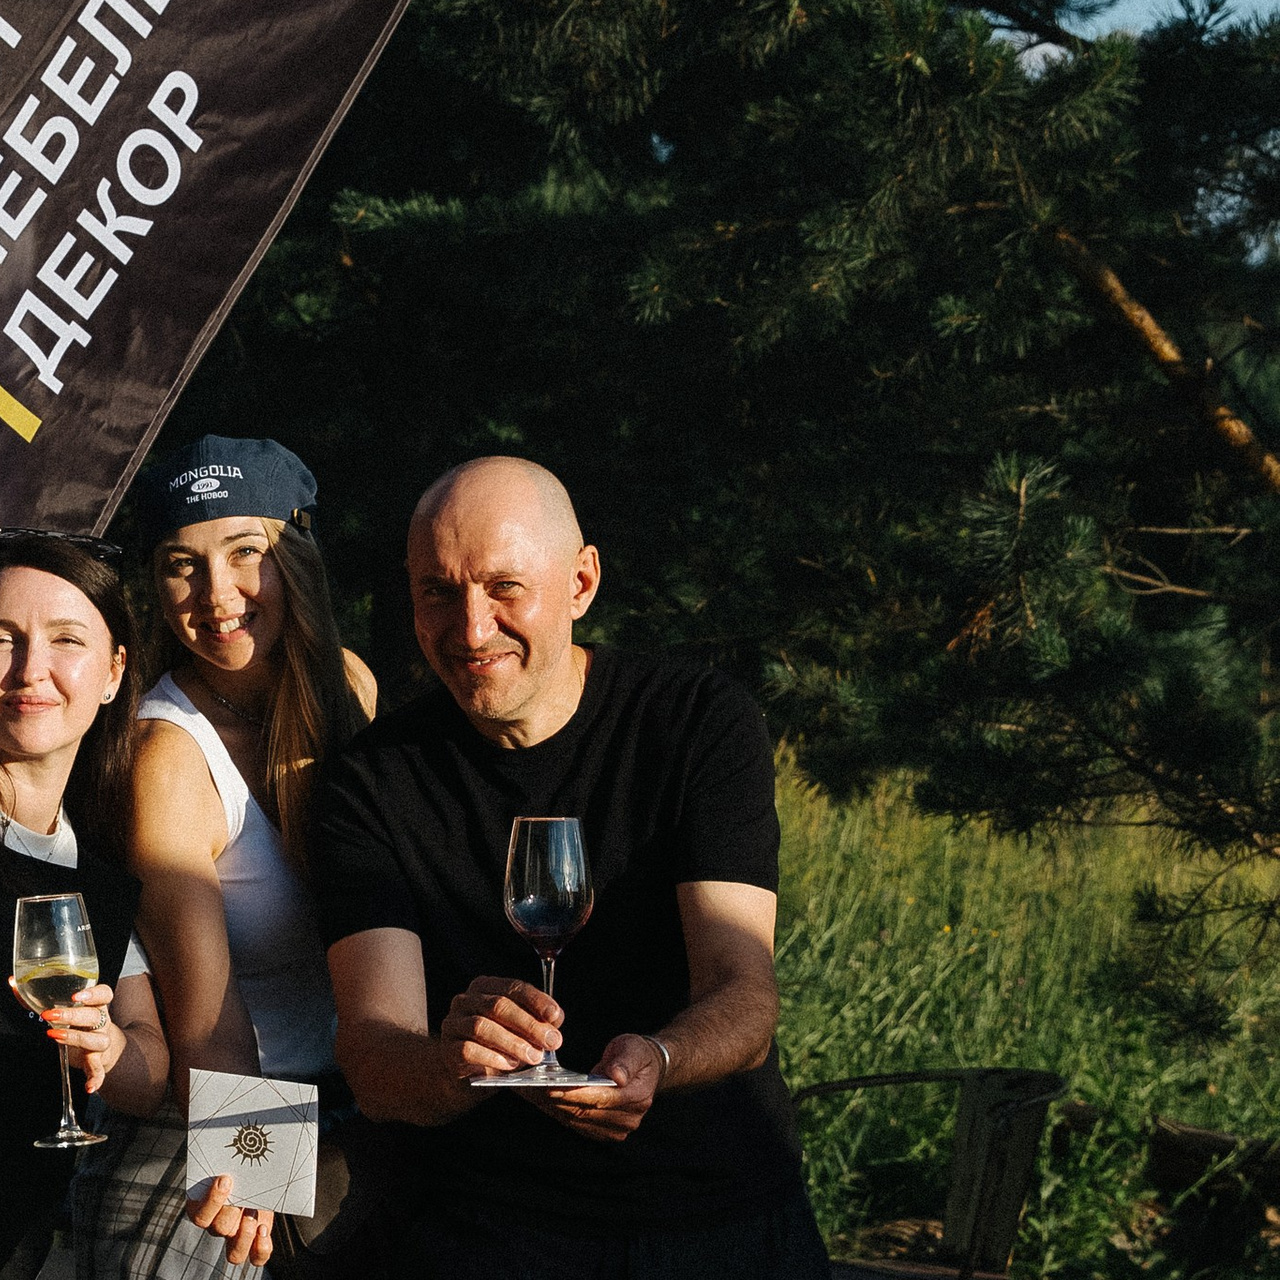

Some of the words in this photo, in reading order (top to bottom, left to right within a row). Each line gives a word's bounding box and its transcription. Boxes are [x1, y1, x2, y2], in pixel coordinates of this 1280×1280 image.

[2, 70, 204, 396] ДЕКОР
[169, 464, 244, 492] MONGOLIA
[195, 481, 215, 490] 1991
[186, 494, 200, 504] THE
